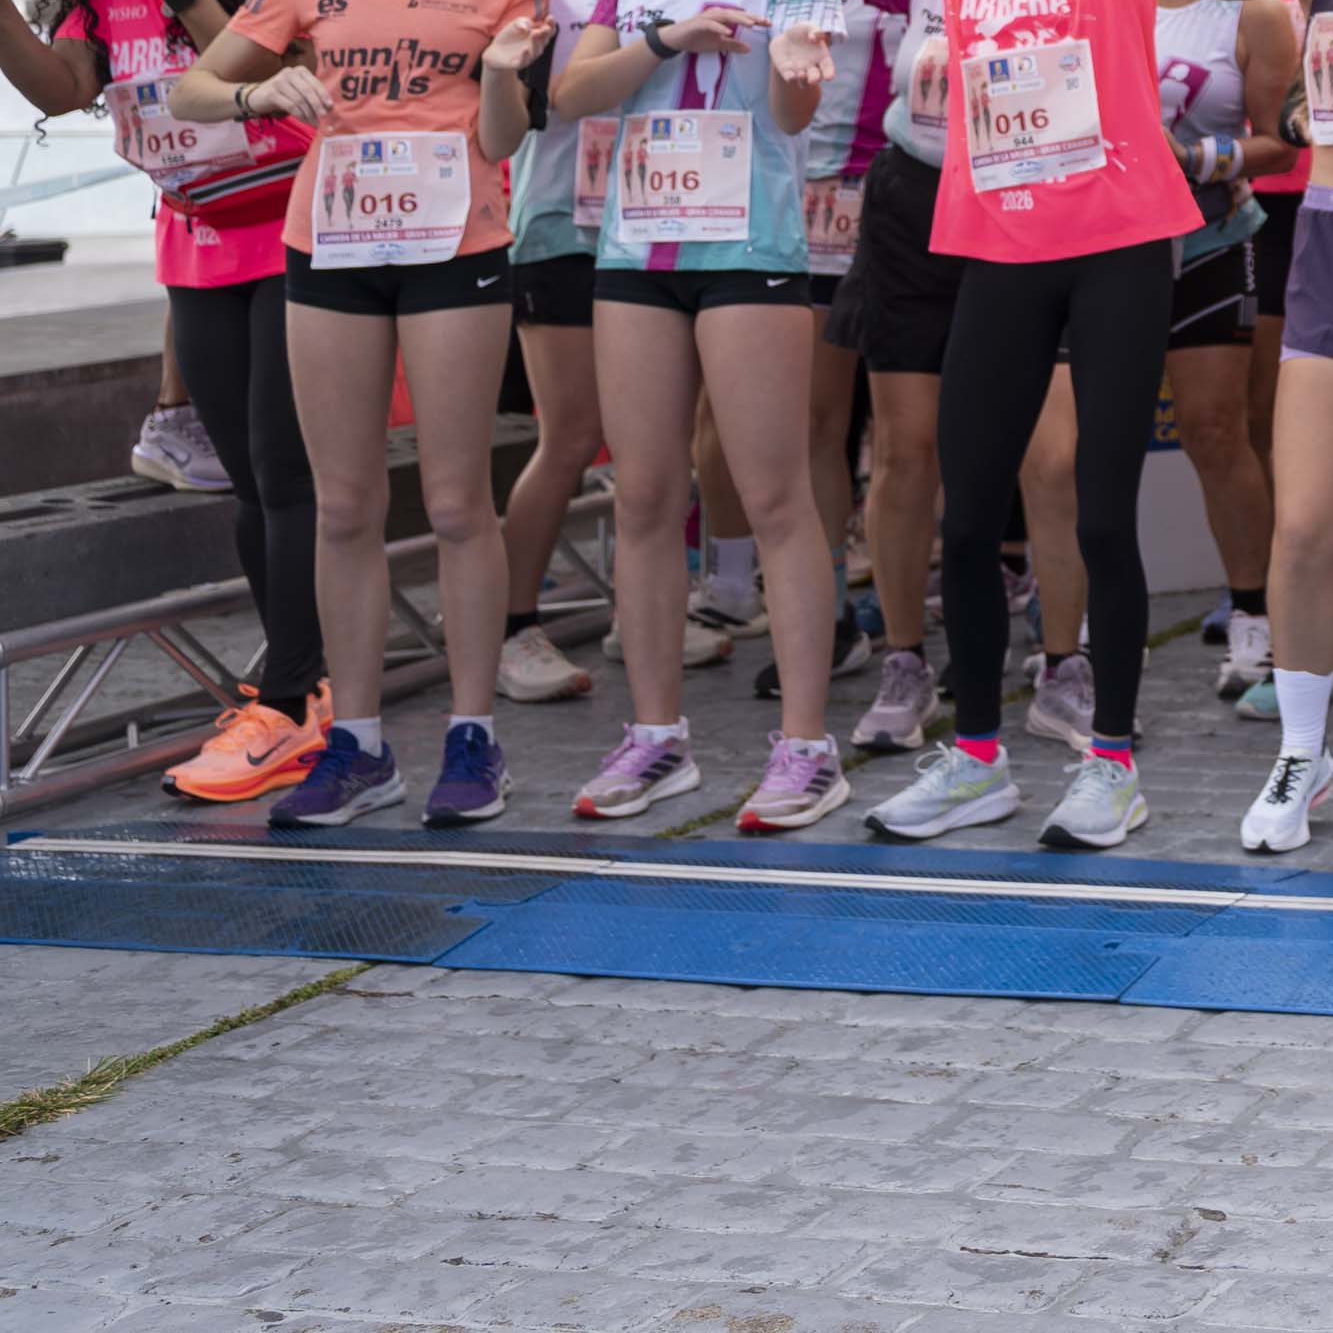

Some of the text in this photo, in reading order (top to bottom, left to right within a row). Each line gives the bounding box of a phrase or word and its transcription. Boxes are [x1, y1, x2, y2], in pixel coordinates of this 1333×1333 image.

[995, 108, 1049, 135] 016
[147, 129, 198, 154] 016
[650, 169, 700, 192] 016
[360, 192, 418, 215] 016
[1001, 189, 1034, 211] 2026
